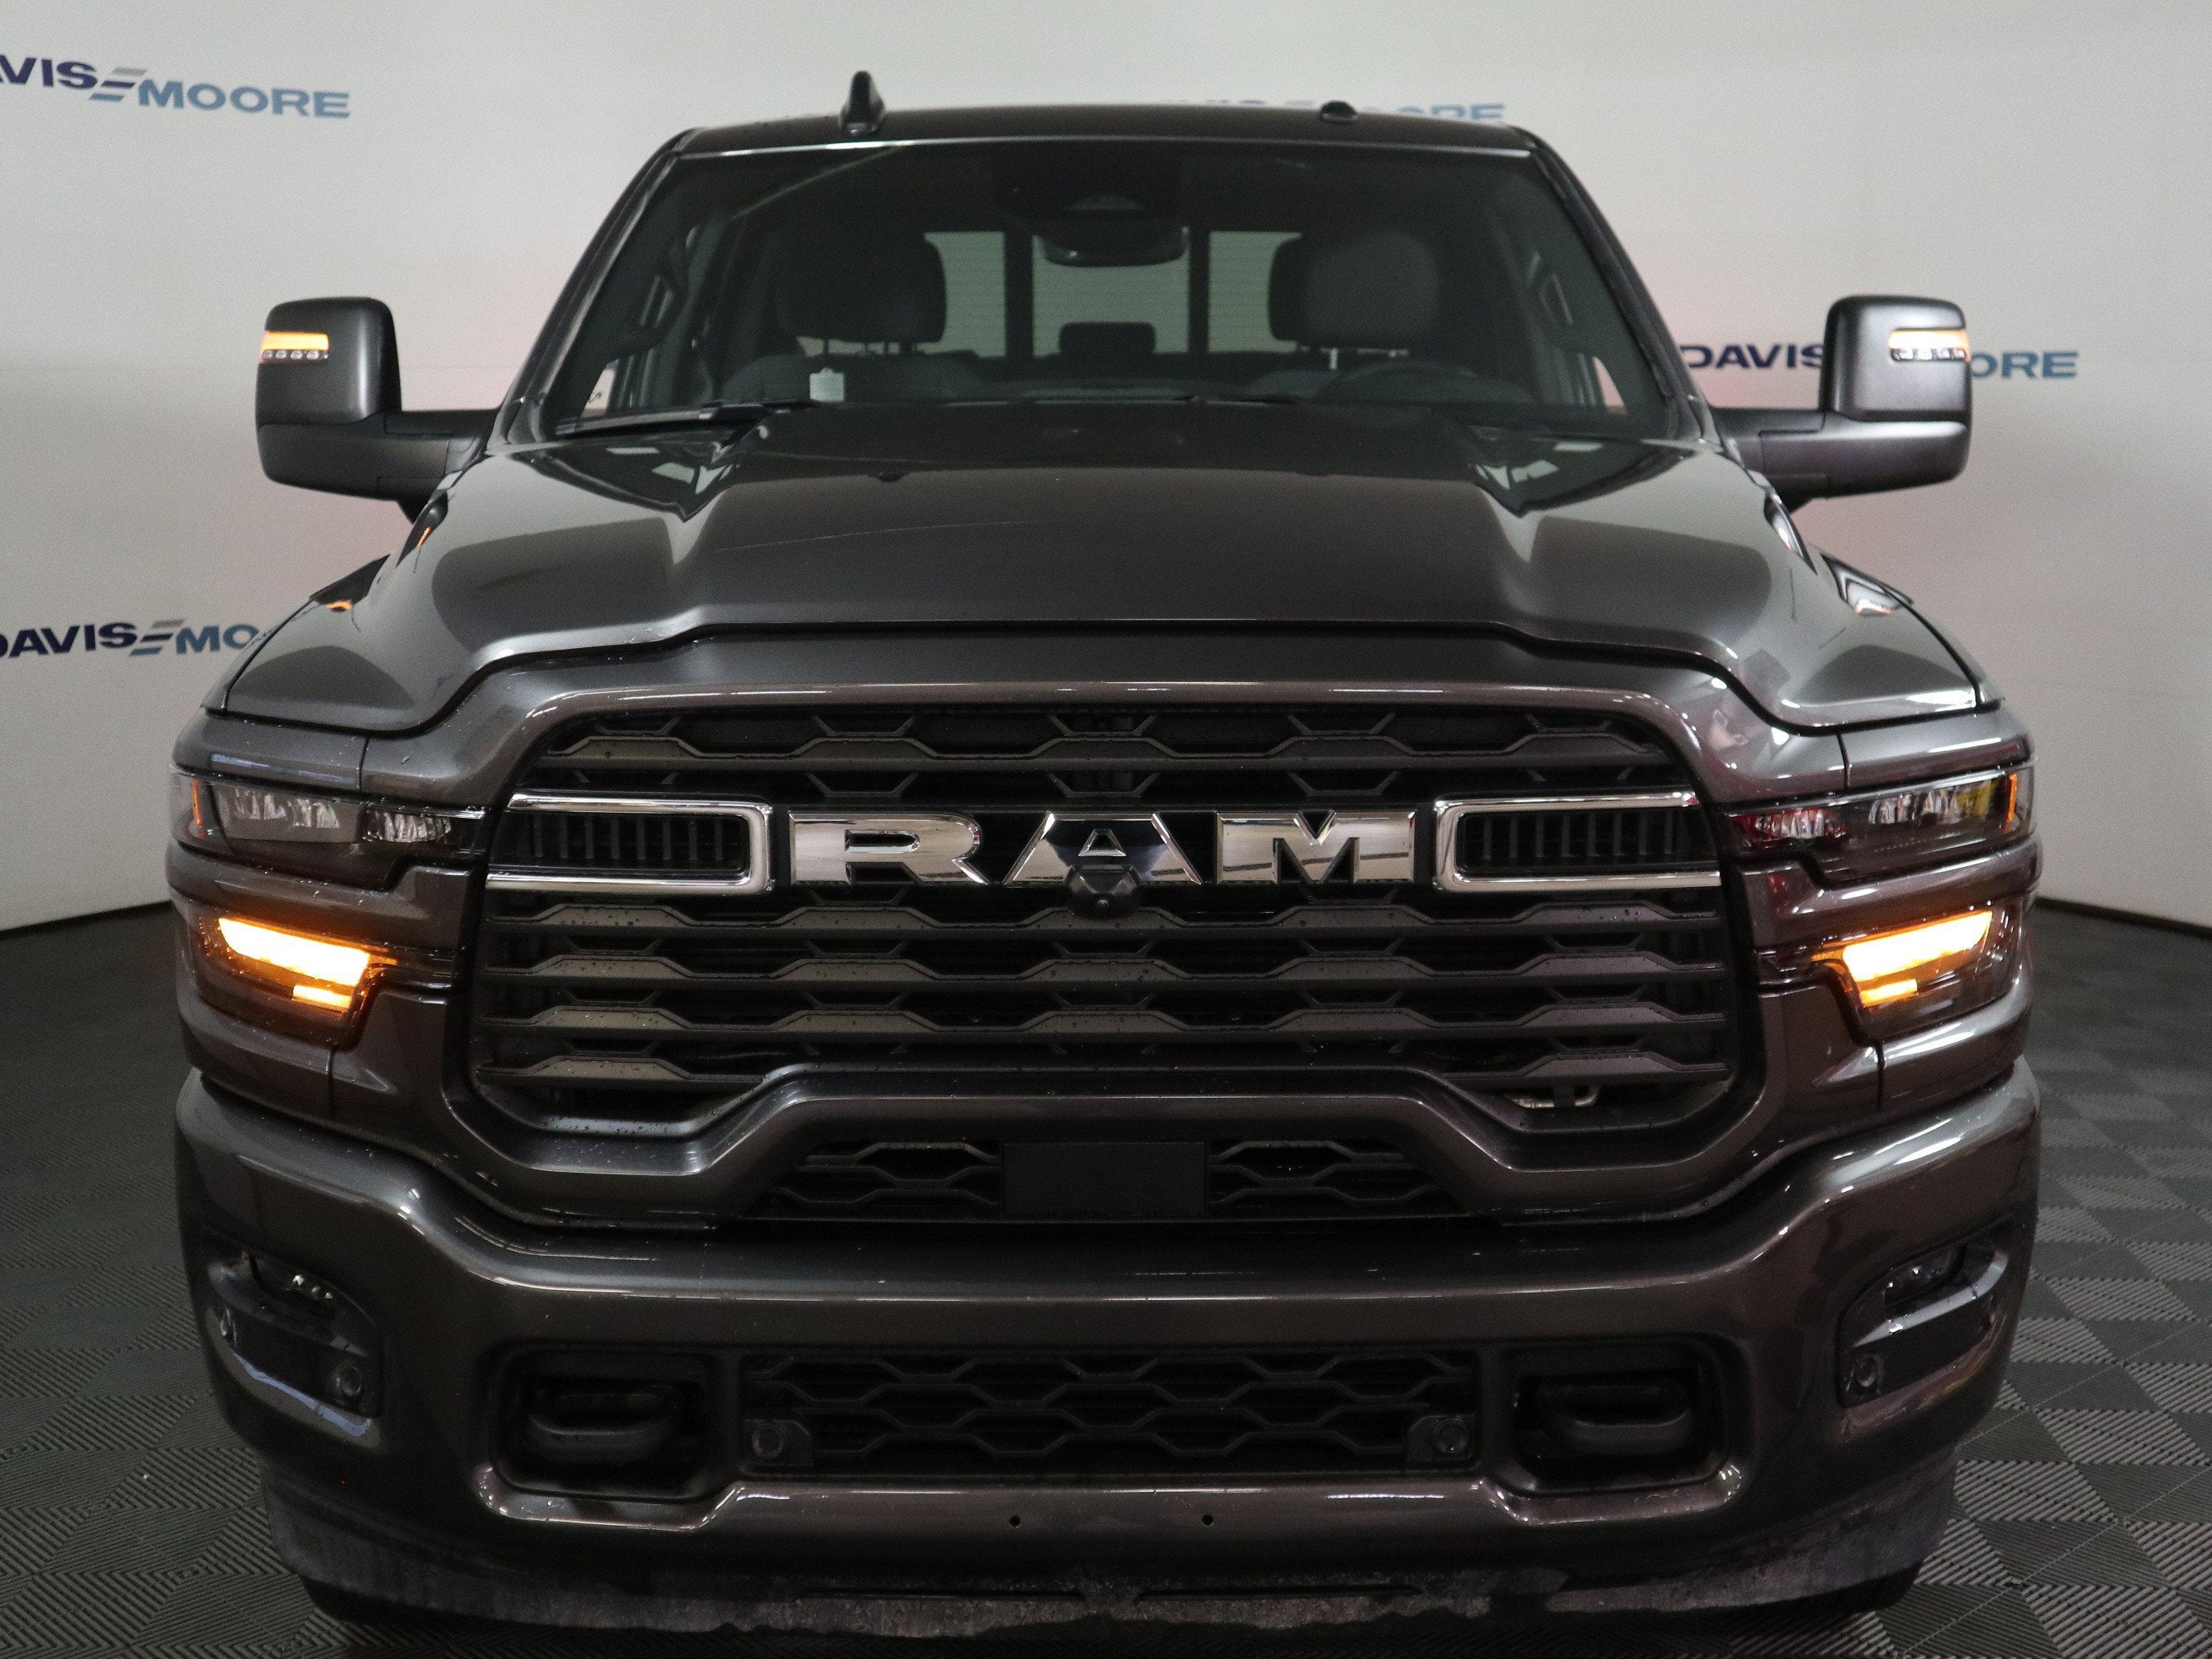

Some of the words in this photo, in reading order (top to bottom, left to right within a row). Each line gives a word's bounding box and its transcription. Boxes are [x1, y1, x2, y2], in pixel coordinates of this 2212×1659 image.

[0, 55, 98, 89] VIS
[138, 79, 351, 119] MOORE
[1679, 344, 1824, 369] DAVIS
[1971, 351, 2079, 378] ORE
[0, 623, 137, 658] AVIS
[788, 810, 1417, 885] RAM
